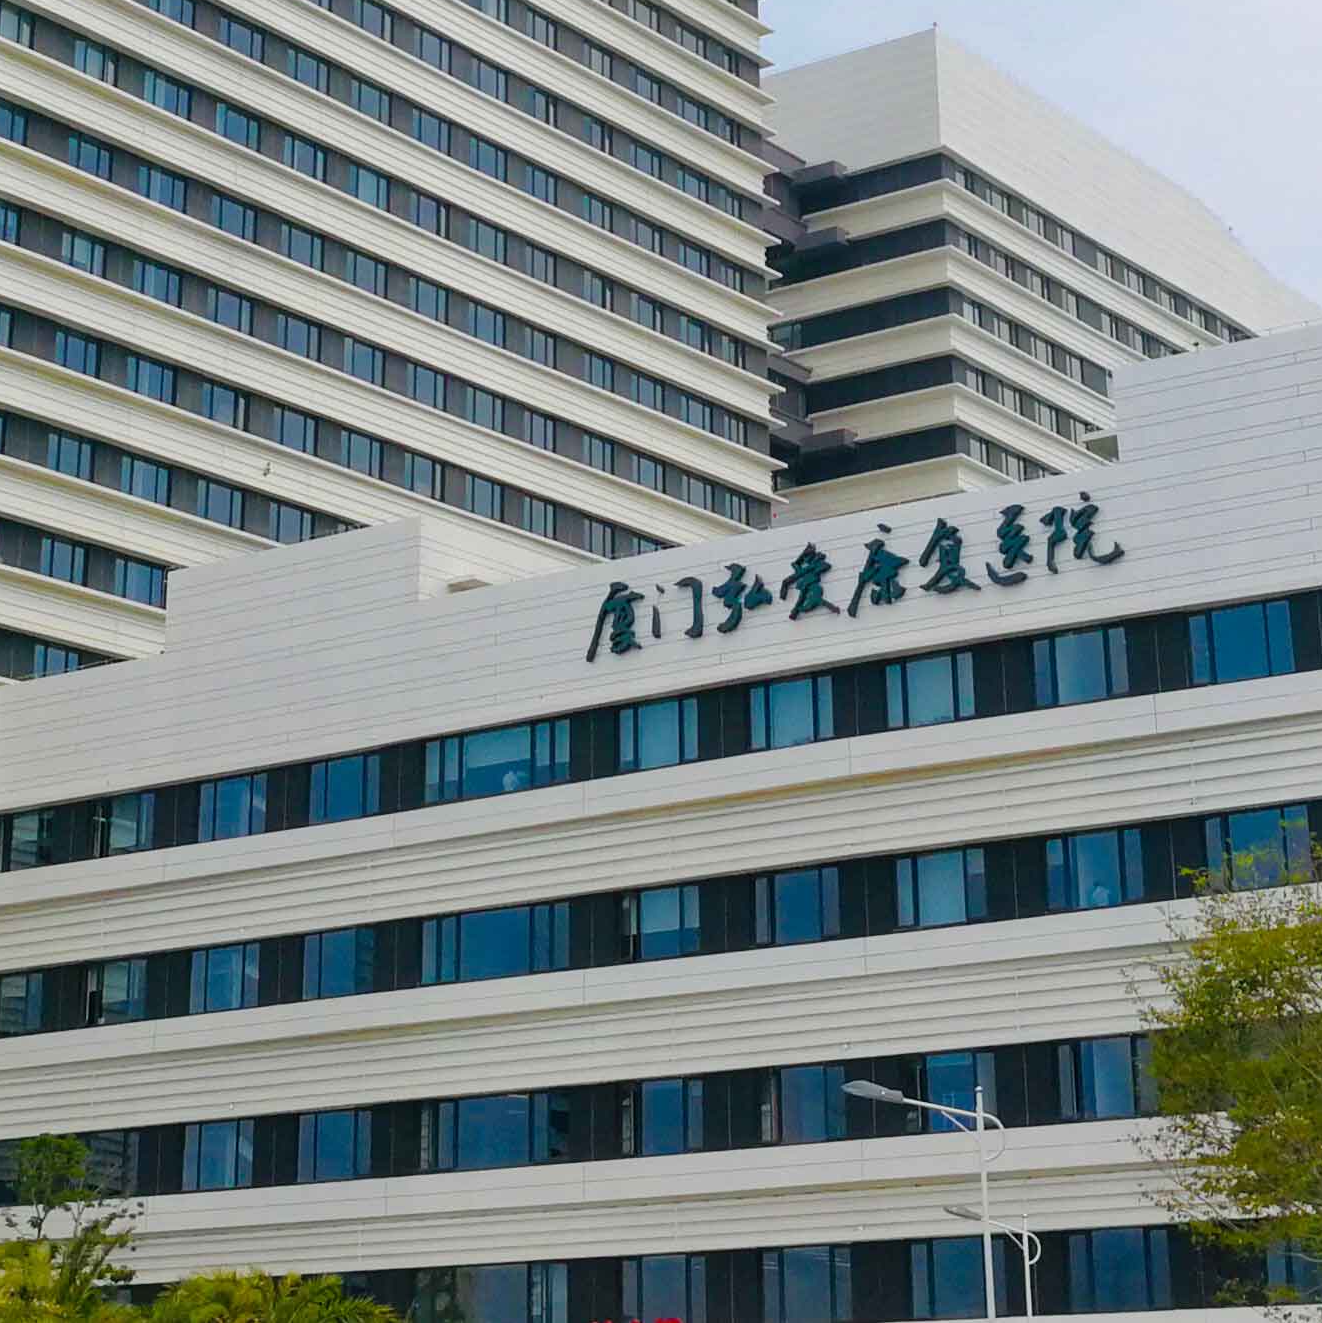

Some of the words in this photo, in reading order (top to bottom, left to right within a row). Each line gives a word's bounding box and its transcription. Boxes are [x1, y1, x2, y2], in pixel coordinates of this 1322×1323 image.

[585, 491, 1125, 663] 厦门弘爱康复医院
